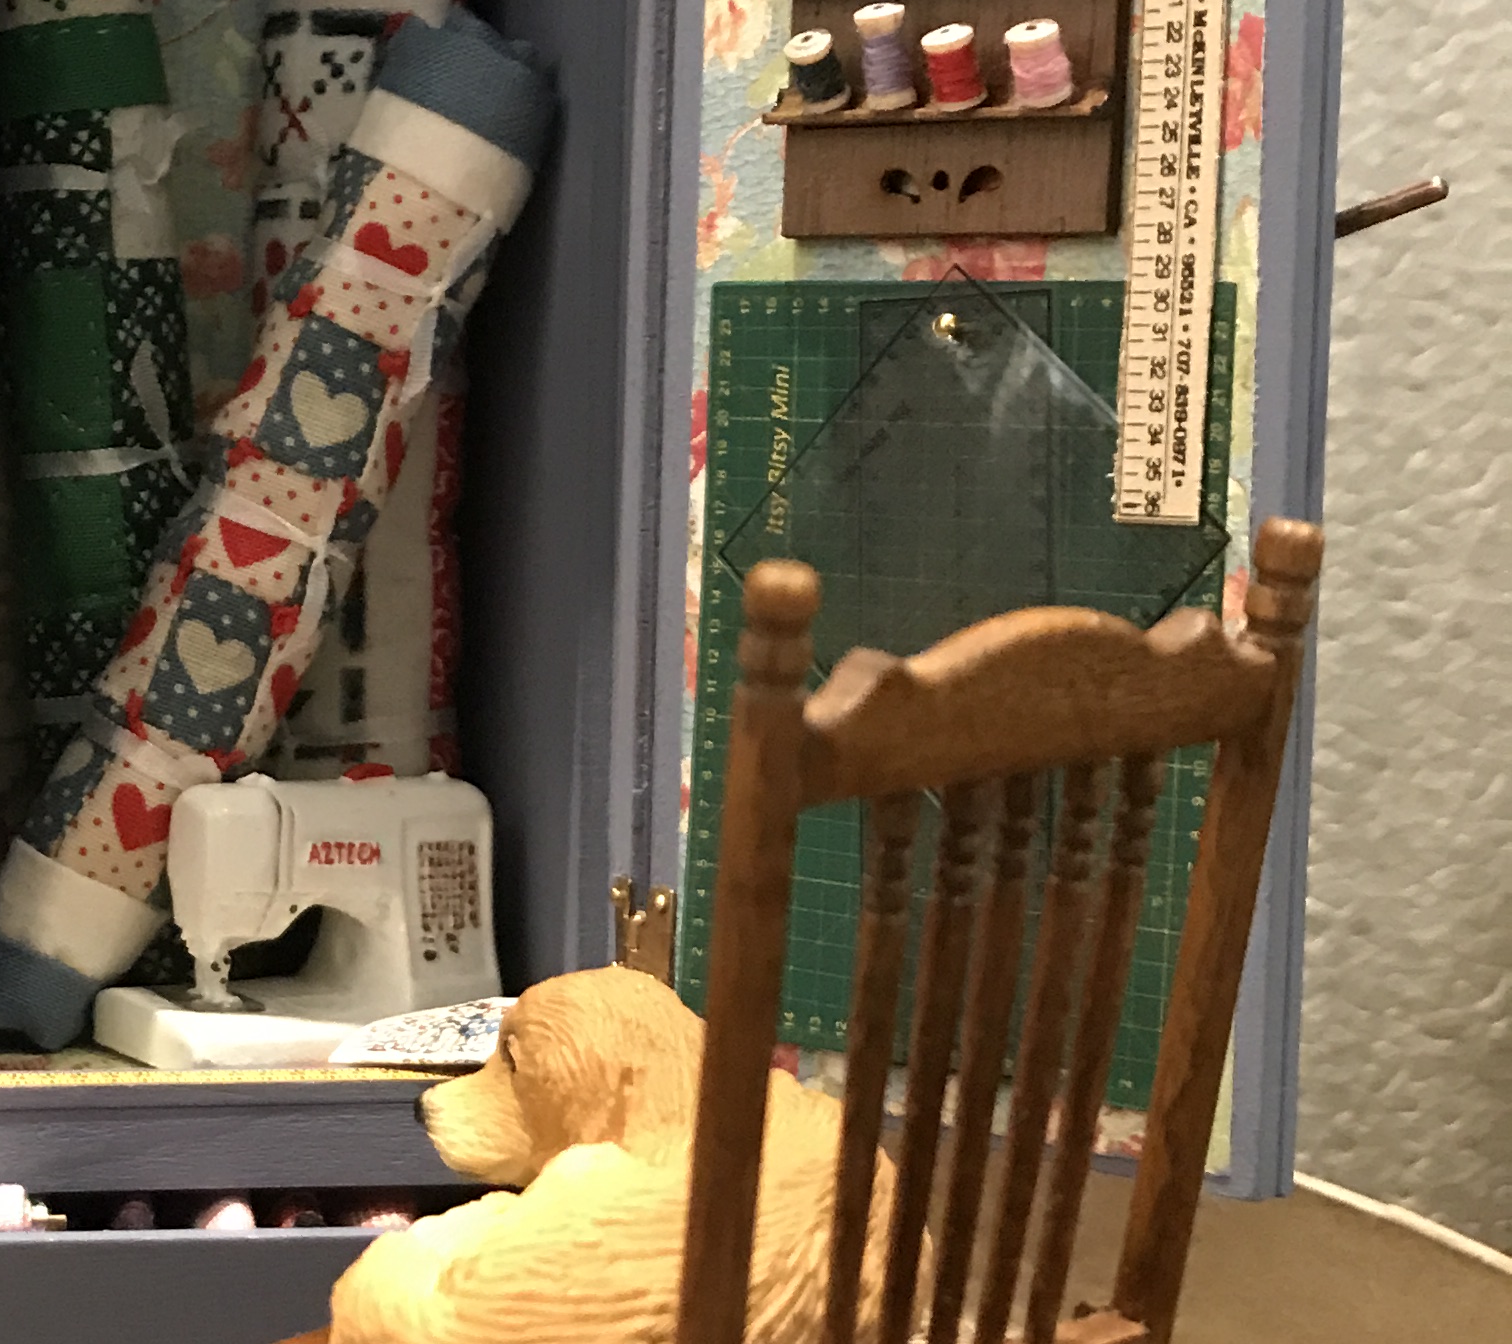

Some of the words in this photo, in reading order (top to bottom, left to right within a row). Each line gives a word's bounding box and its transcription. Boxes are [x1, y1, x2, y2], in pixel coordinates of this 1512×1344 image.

[1166, 21, 1183, 43] 22
[1164, 55, 1182, 78] 23
[1163, 88, 1180, 110] 24
[1187, 9, 1208, 180] McKINLEYVILLE
[1162, 121, 1179, 143] 25
[1160, 154, 1177, 177] 26
[1158, 186, 1175, 209] 27
[1184, 200, 1199, 228] CA
[1157, 221, 1174, 244] 28
[1155, 255, 1172, 278] 29
[1154, 288, 1170, 312] 30
[1152, 323, 1168, 344] 31
[1150, 356, 1166, 380] 32
[771, 363, 790, 420] Mini
[1149, 389, 1165, 412] 33
[1147, 423, 1164, 445] 34
[1145, 457, 1162, 481] 35
[308, 842, 380, 865] AZTECH
